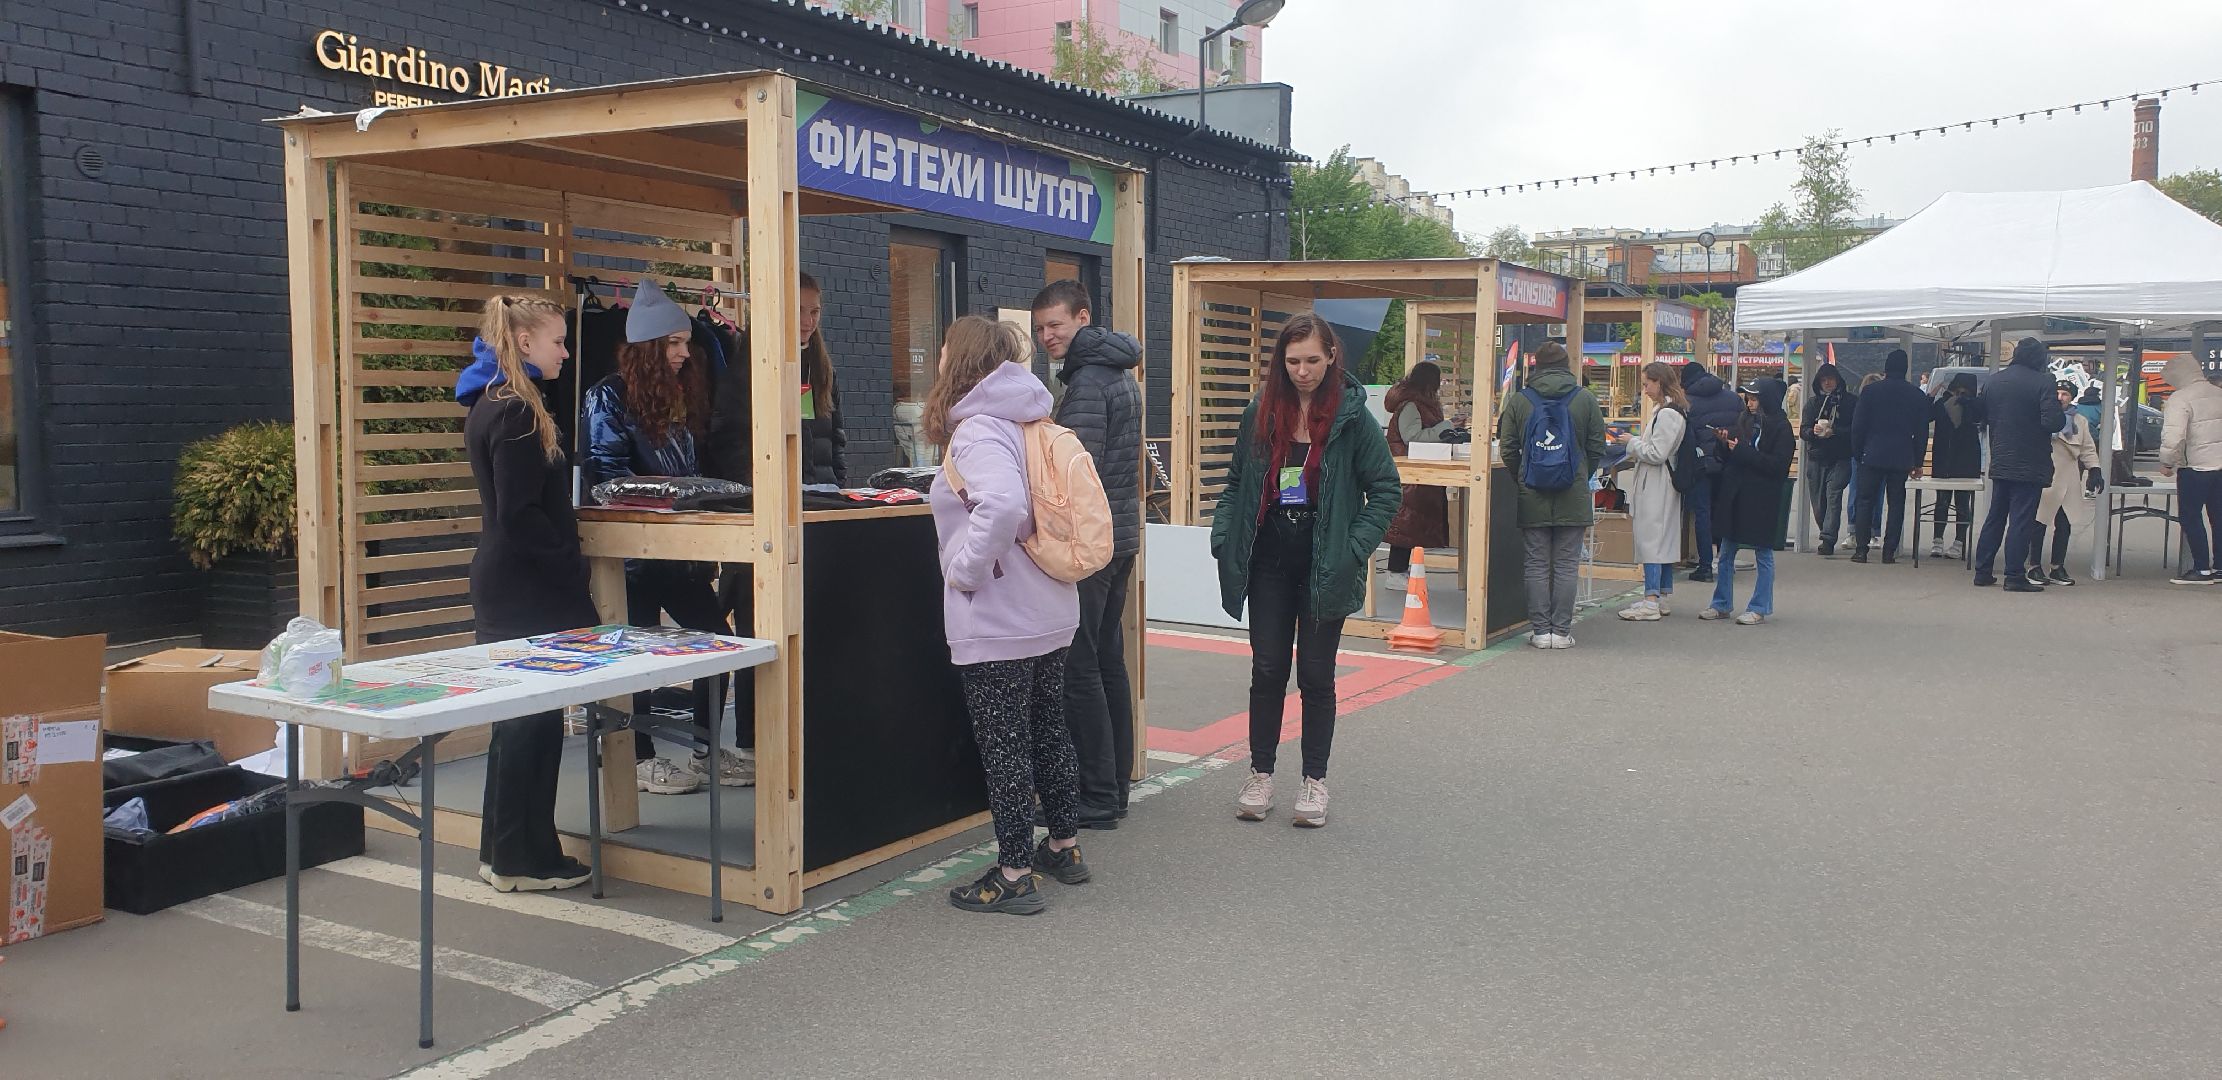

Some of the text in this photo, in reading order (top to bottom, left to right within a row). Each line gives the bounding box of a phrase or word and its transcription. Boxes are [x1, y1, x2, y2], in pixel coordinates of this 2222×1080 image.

[316, 30, 566, 98] Giardino Magi
[808, 118, 1094, 224] ФИЗТЕХИ ШУТЯТ
[1502, 276, 1557, 309] TECHINSIDER
[1623, 355, 1684, 364] РЕГРАЦИЯ
[1721, 356, 1784, 364] РЕИСТРАЦИЯ
